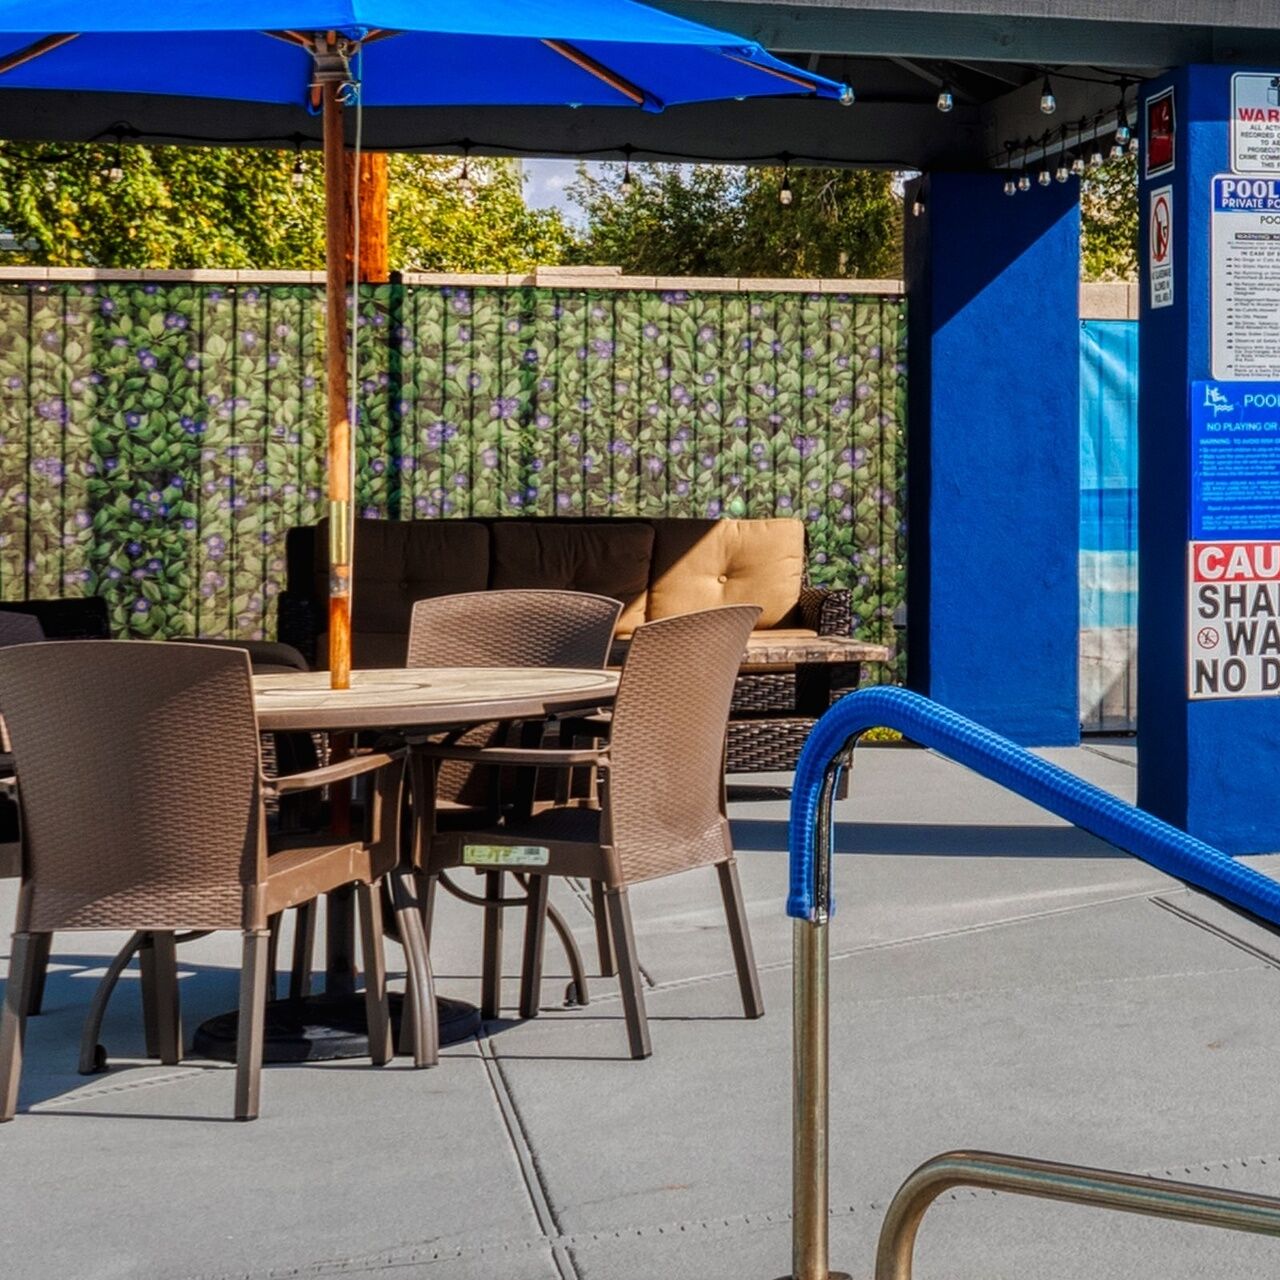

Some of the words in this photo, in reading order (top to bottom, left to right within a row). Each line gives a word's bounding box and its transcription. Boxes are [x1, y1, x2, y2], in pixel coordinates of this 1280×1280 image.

[1221, 180, 1279, 199] POOL
[1221, 198, 1263, 208] PRIVATE
[1207, 422, 1221, 431] NO
[1223, 422, 1262, 431] PLAYING
[1264, 422, 1278, 431] OR
[1195, 658, 1246, 693] NO
